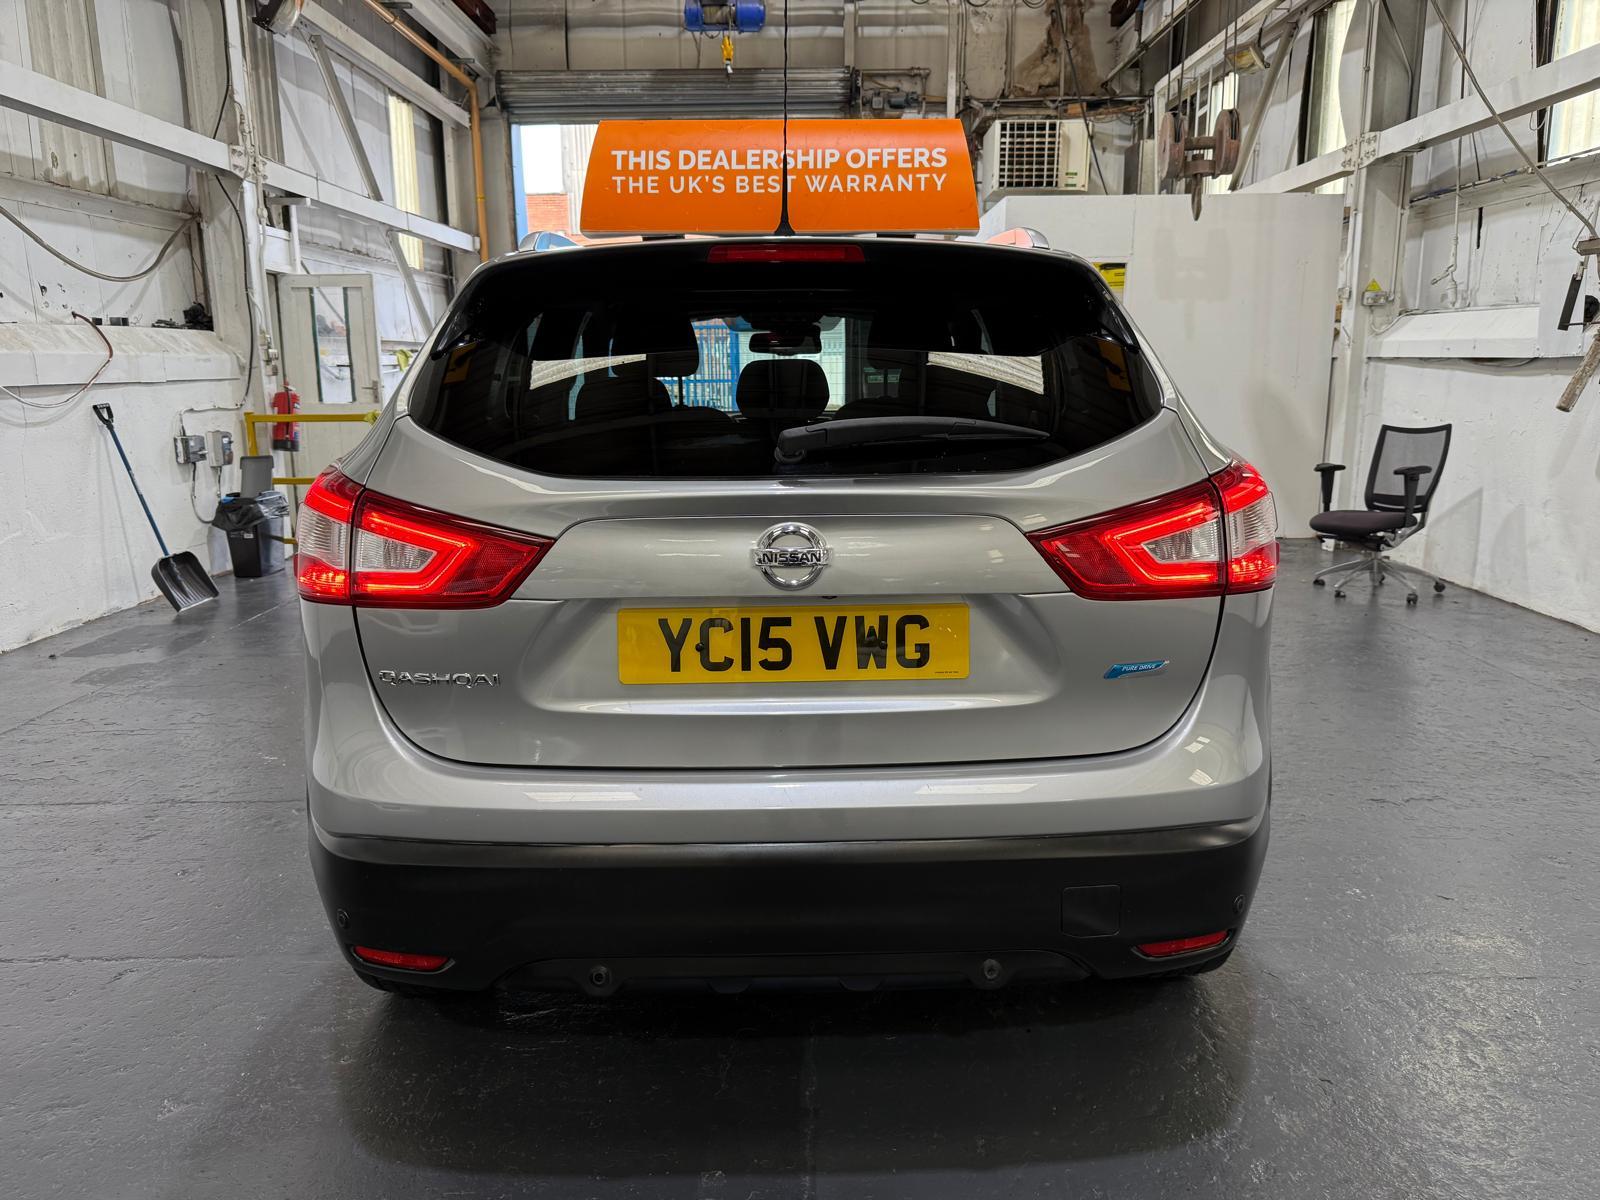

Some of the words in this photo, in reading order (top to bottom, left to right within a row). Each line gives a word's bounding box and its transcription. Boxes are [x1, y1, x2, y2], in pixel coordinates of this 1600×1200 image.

[611, 149, 671, 171] THIS
[677, 147, 840, 170] DEALERSHIP
[845, 147, 948, 169] OFFERS
[611, 176, 659, 194] THE
[669, 175, 725, 193] UK'S
[735, 174, 797, 193] BEST
[804, 173, 948, 192] WARRANTY
[762, 552, 821, 564] NISSAN
[657, 616, 793, 673] YC15
[813, 614, 931, 670] VWG
[379, 670, 499, 689] QASHQAI
